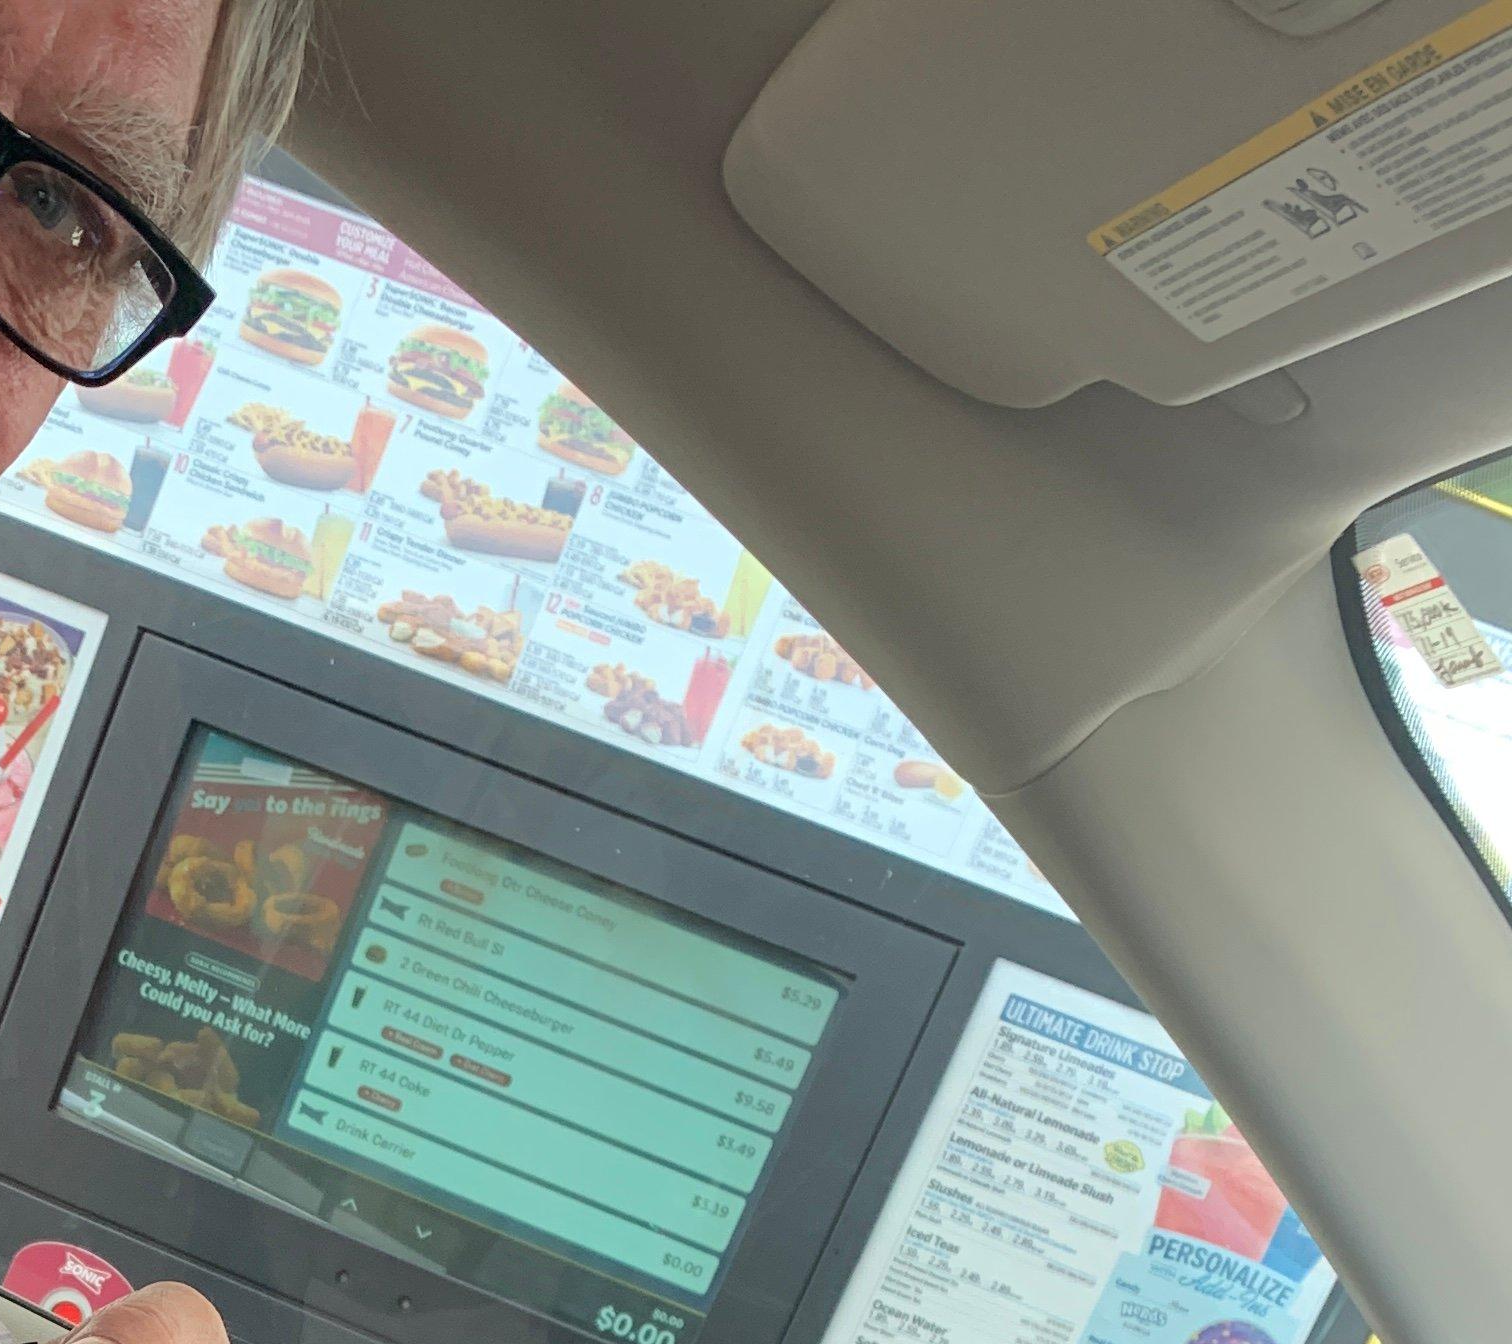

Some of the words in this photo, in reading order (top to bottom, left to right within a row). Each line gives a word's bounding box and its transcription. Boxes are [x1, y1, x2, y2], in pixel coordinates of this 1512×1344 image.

[192, 788, 231, 814] Say
[266, 795, 288, 814] to
[293, 797, 325, 815] the
[434, 920, 463, 939] Red
[462, 931, 491, 950] Bull
[115, 947, 176, 986] Cheesy,
[171, 971, 219, 1005] Melty
[229, 994, 273, 1023] What
[270, 1010, 313, 1040] More
[399, 957, 410, 970] 2
[410, 961, 451, 986] Green
[450, 977, 482, 998] Chili
[481, 989, 576, 1037] Cheeseburger
[137, 980, 184, 1011] Could
[180, 1001, 212, 1025] you
[211, 1010, 244, 1035] Ask
[241, 1022, 276, 1048] for?
[382, 999, 400, 1015] RT
[401, 1007, 421, 1023] 44
[420, 1015, 451, 1036] Diet
[450, 1027, 467, 1043] Dr
[466, 1034, 516, 1063] Pepper
[997, 1025, 1058, 1057] Signature
[1003, 996, 1085, 1045] ULTIMATE
[1082, 1028, 1139, 1065] DRINK
[1136, 1050, 1186, 1084] STOP
[358, 1059, 377, 1075] RT
[377, 1067, 397, 1082] 44
[397, 1075, 432, 1097] Coke
[84, 1090, 106, 1117] 3
[969, 1085, 1037, 1119] All-Natural
[1036, 1113, 1101, 1145] Lemonade
[336, 1118, 370, 1142] Drink
[372, 1134, 416, 1159] Carrier
[948, 1131, 1013, 1165] Lemonade
[1013, 1158, 1027, 1171] or
[1026, 1163, 1080, 1191] Limeade
[1078, 1183, 1115, 1206] Slush
[926, 1178, 975, 1205] Slushes
[905, 1225, 934, 1245] Iced
[933, 1236, 961, 1255] Teas
[64, 1262, 105, 1286] SONIC
[663, 1252, 703, 1277] $0.00
[1145, 1230, 1297, 1308] PERSONALIZE
[653, 1308, 684, 1329] $0.00
[870, 1299, 911, 1322] Ocean
[910, 1315, 948, 1338] Water
